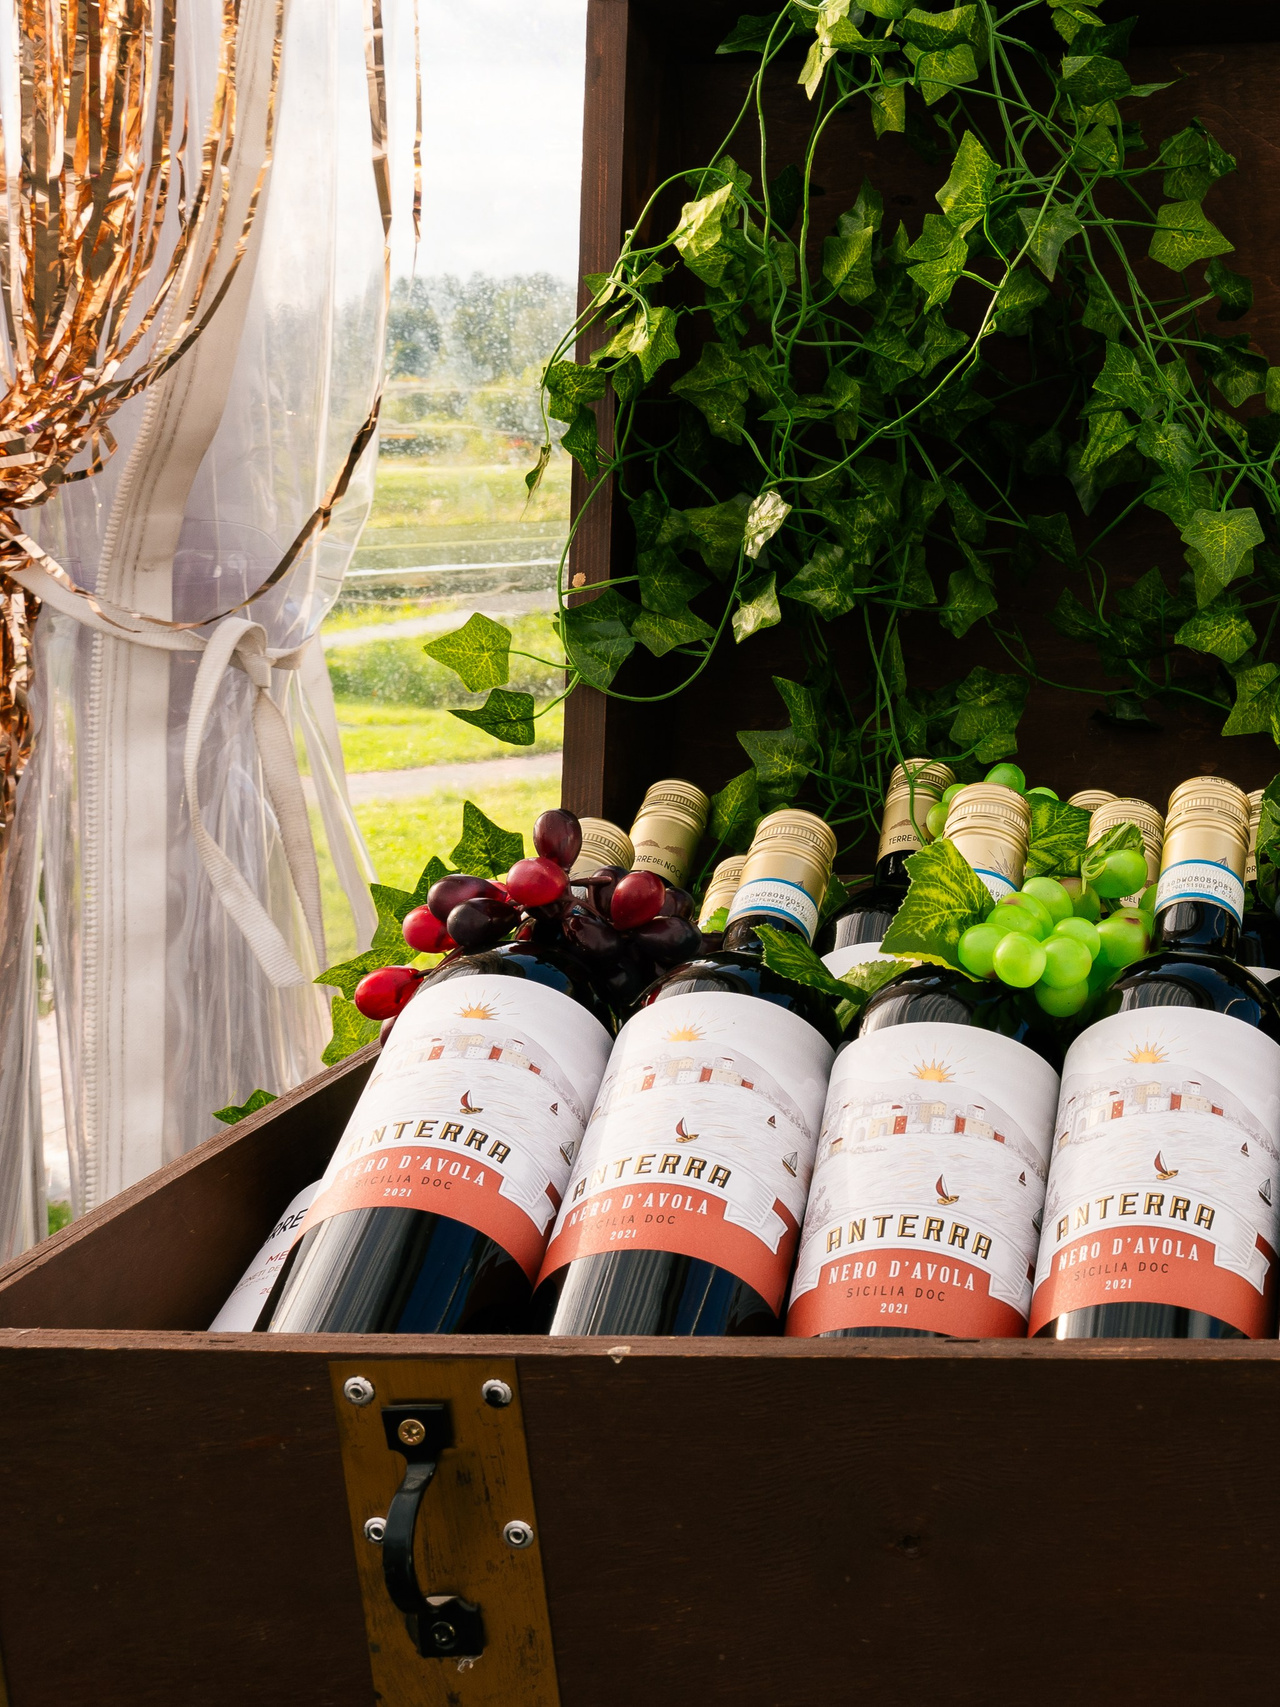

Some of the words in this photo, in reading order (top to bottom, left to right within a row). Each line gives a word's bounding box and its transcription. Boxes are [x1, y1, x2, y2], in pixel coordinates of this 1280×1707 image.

[889, 834, 912, 845] TERRE
[652, 857, 664, 866] DEL
[345, 1119, 512, 1164] ANTERRA
[398, 1155, 486, 1187] D'AVOLA
[572, 1153, 731, 1203] ANTERRA
[383, 1187, 413, 1197] 2021
[421, 1176, 453, 1190] DOC
[568, 1198, 612, 1228] NERO
[622, 1192, 708, 1215] D'AVOLA
[1056, 1192, 1216, 1243] ANTERRA
[645, 1214, 676, 1225] DOC
[609, 1229, 636, 1241] 2021
[826, 1214, 993, 1260] ANTERRA
[1058, 1238, 1101, 1272] NERO
[1112, 1237, 1199, 1262] D'AVOLA
[828, 1260, 877, 1285] NERO
[888, 1260, 975, 1291] D'AVOLA
[1074, 1263, 1128, 1281] SICILIA
[1138, 1261, 1169, 1274] DOC
[1104, 1278, 1133, 1291] 2021
[846, 1286, 904, 1298] SICILIA
[915, 1289, 945, 1302] DOC
[880, 1302, 909, 1314] 2021
